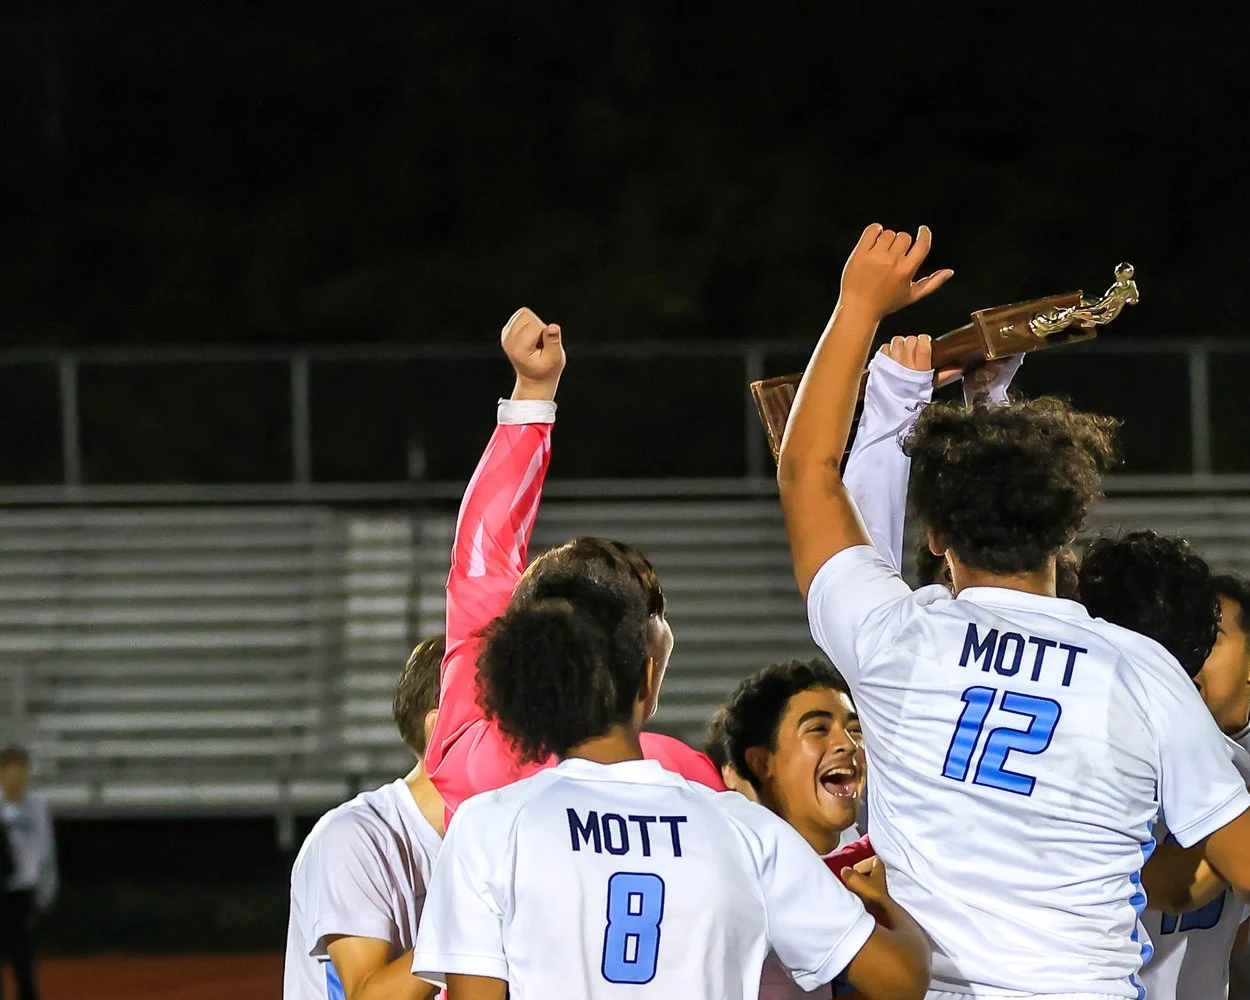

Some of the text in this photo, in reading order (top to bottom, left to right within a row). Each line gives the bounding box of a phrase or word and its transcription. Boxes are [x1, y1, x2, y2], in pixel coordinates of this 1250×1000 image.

[958, 622, 1088, 687] MOTT
[941, 685, 1062, 797] 12
[566, 807, 688, 858] MOTT
[601, 871, 665, 985] 8
